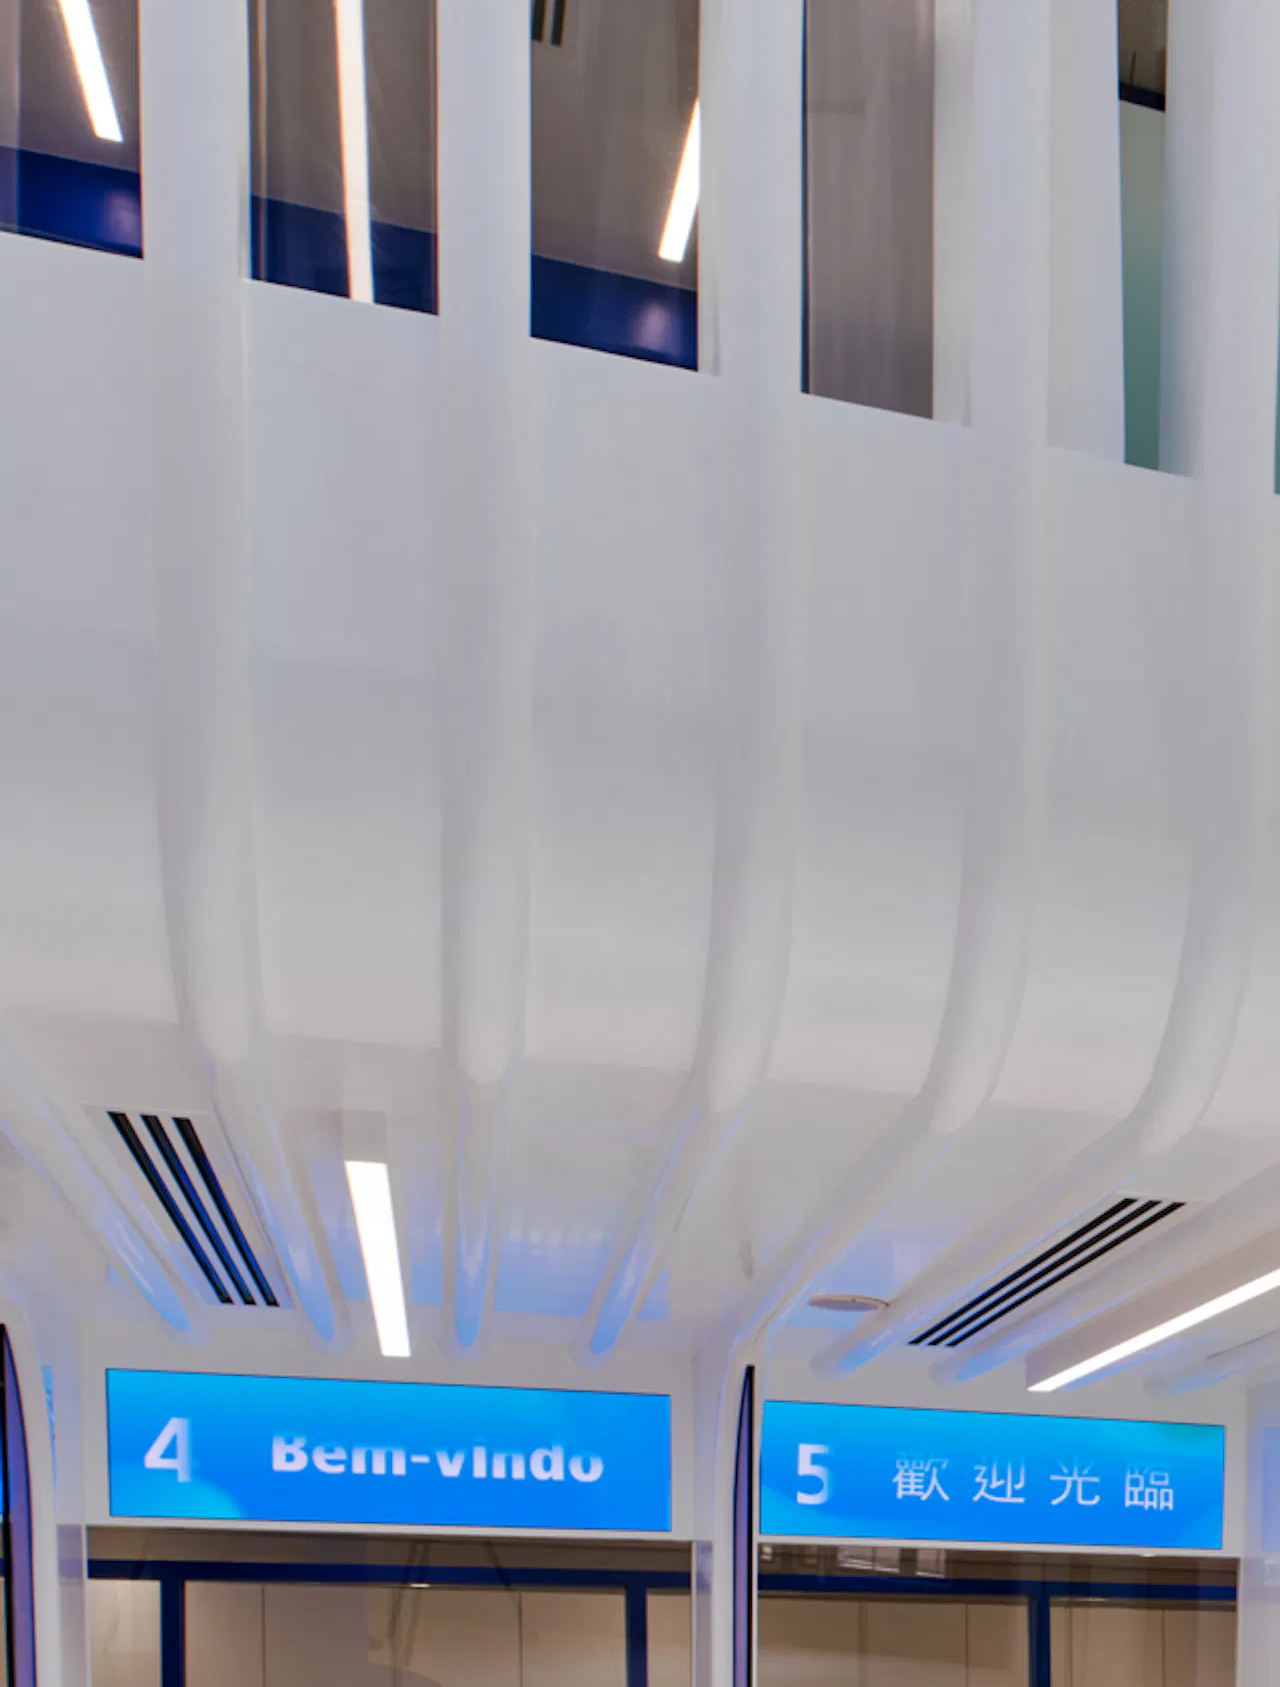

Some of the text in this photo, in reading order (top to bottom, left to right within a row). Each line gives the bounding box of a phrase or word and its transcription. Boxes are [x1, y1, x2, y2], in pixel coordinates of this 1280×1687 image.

[144, 1416, 604, 1483] 4 Bem-vindo
[796, 1443, 1174, 1510] 5 歡迎光臨
